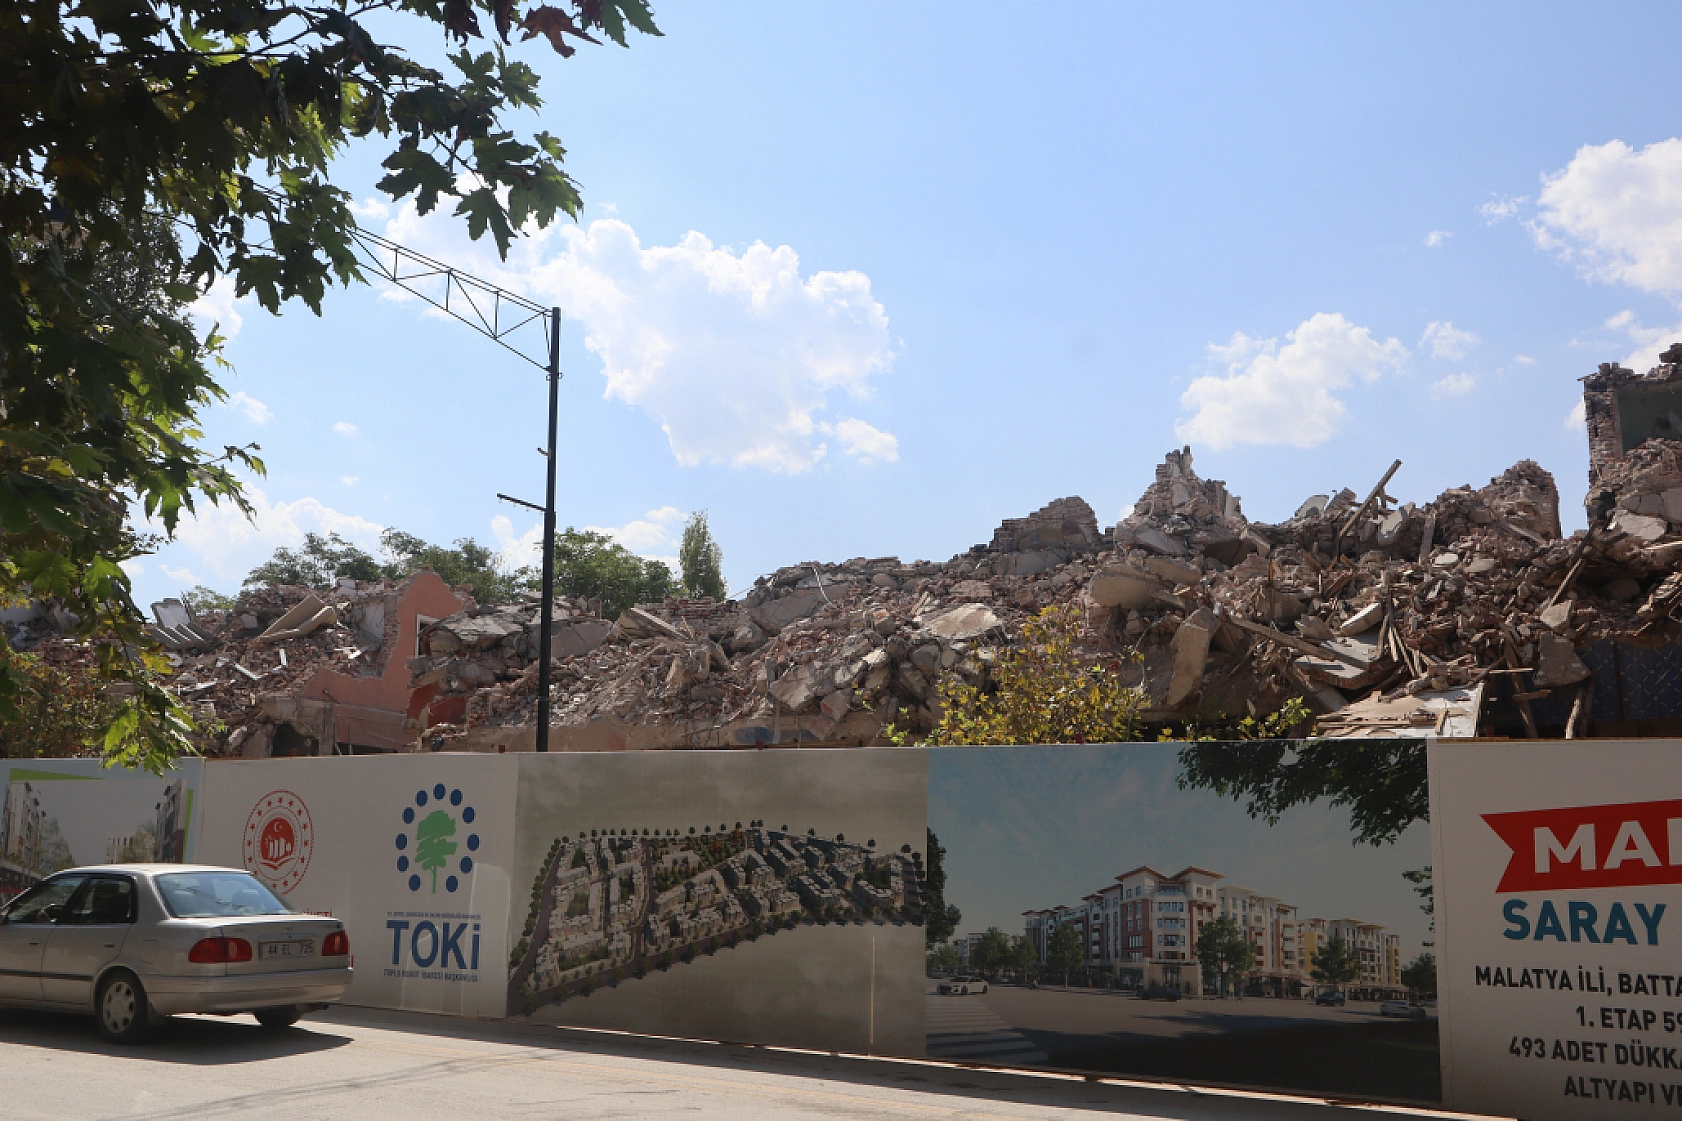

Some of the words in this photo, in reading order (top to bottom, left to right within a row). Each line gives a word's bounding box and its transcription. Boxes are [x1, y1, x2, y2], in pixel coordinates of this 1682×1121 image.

[1502, 899, 1667, 946] SARAY
[283, 944, 292, 955] EL
[1475, 965, 1573, 991] MALATYA
[1578, 965, 1613, 997] İLİ,
[1575, 1006, 1595, 1026] 1.
[1601, 1007, 1656, 1031] ETAP
[1509, 1036, 1546, 1059] 493
[1552, 1039, 1608, 1063] ADET
[1614, 1039, 1682, 1070] DÜKK
[1564, 1075, 1655, 1104] ALTYAPI
